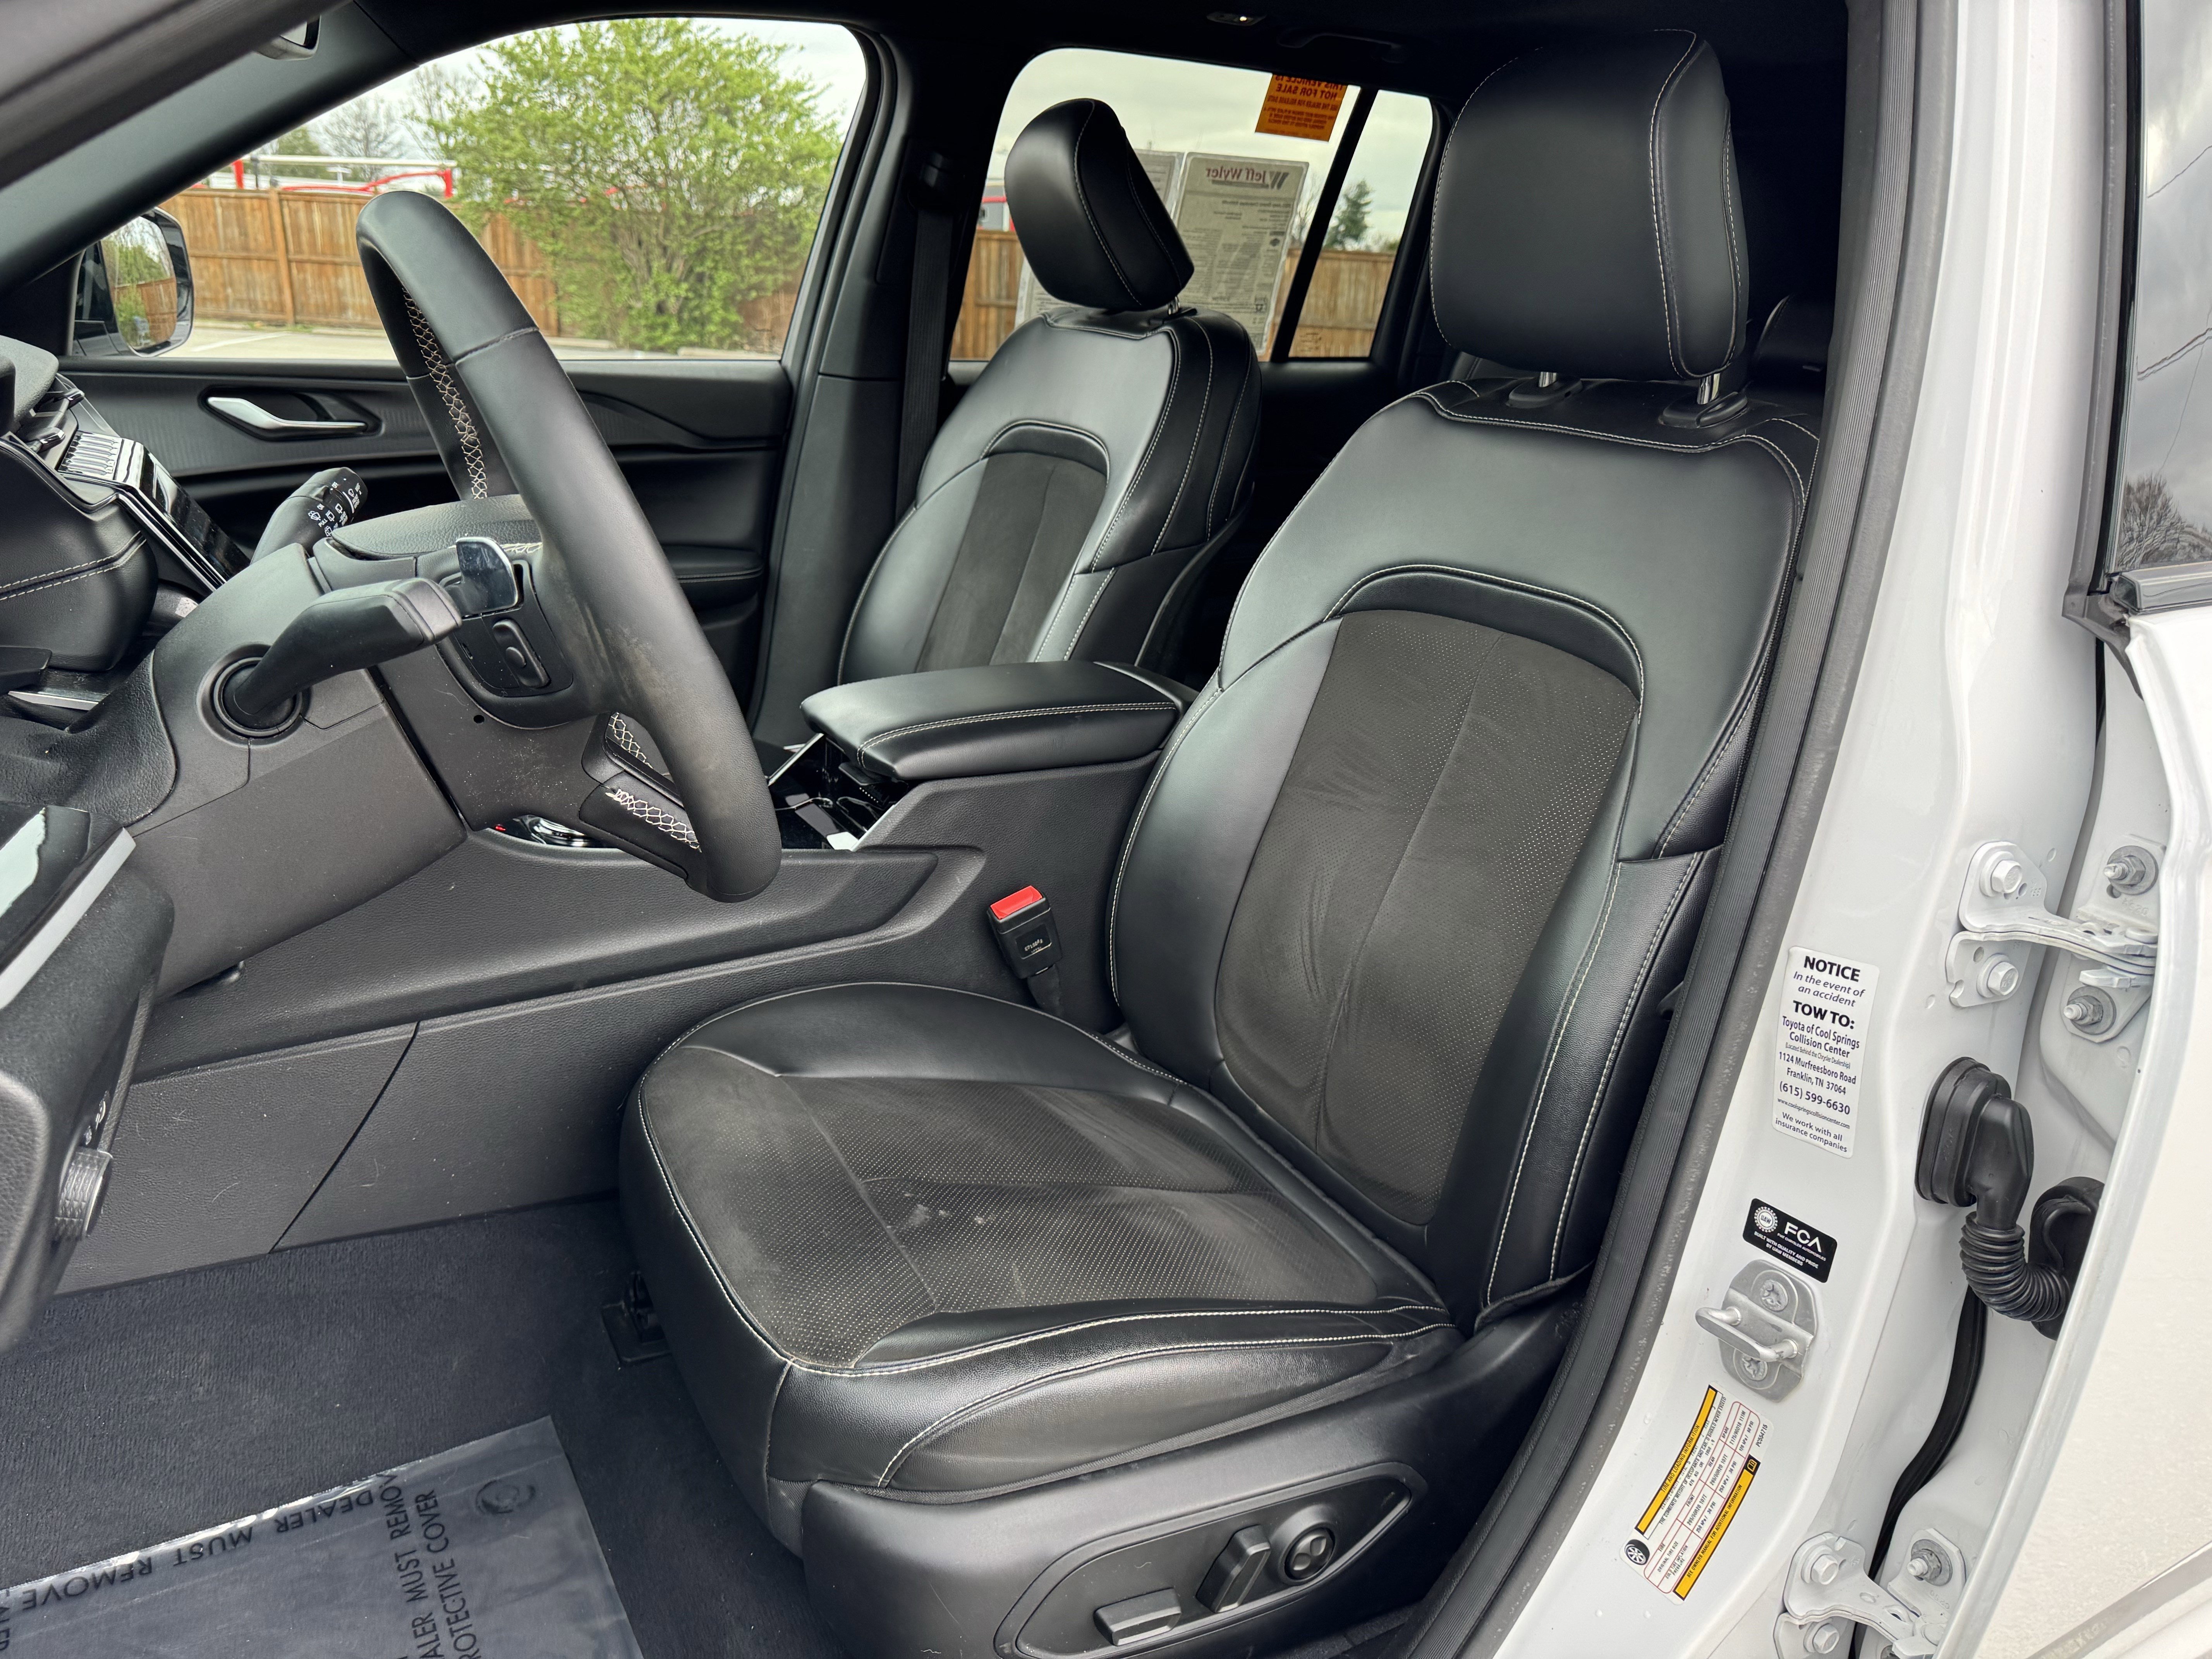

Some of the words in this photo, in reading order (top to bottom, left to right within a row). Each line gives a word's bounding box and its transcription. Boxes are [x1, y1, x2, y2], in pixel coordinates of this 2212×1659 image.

[318, 518, 328, 527] PULL
[1793, 971, 1803, 981] In
[1805, 975, 1821, 985] the
[1823, 982, 1851, 994] event
[1804, 956, 1860, 982] NOTICE
[1793, 1000, 1827, 1020] TOW
[1830, 1011, 1855, 1029] TO:
[1813, 991, 1856, 1007] accident
[1783, 1016, 1805, 1031] Toyota
[1807, 1024, 1815, 1034] of
[1815, 1026, 1831, 1039] Cool
[1832, 1031, 1860, 1050] Springs
[1790, 1032, 1822, 1049] Collision
[1824, 1042, 1850, 1058] Center
[1779, 1051, 1794, 1063] 1124
[1795, 1056, 1838, 1078] Murfreesboro
[1839, 1072, 1856, 1084] Road
[1787, 1067, 1814, 1085] Franklin,
[1815, 1077, 1824, 1087] TN
[1826, 1081, 1846, 1095] 37064
[1780, 1081, 1802, 1099] (615)
[1805, 1091, 1850, 1115] 599-6630
[1776, 1118, 1808, 1137] insurance
[1809, 1133, 1847, 1152] companies
[1783, 1112, 1793, 1121] We
[1795, 1118, 1813, 1130] work
[1815, 1127, 1831, 1137] with
[1766, 1238, 1778, 1246] WITH
[1778, 1244, 1796, 1255] QUALITY
[1784, 1222, 1822, 1252] FCA
[1782, 1252, 1803, 1266] MEMBERS
[1675, 1453, 1686, 1473] LOADING
[1685, 1425, 1700, 1454] INFORMTION
[1676, 1484, 1685, 1499] WEIGHT
[1687, 1458, 1700, 1479] OCCUPANTS
[1701, 1437, 1709, 1450] CARO
[276, 1487, 373, 1534] DEALER
[376, 1473, 411, 1540] REMOV
[1686, 1494, 1695, 1507] FRONT
[415, 1489, 449, 1553] COVER
[1692, 1554, 1703, 1570] OWNERS
[1701, 1540, 1712, 1555] MANUAL
[1715, 1510, 1729, 1531] ADDITIONAL
[1727, 1484, 1742, 1510] INFORMATION
[173, 1527, 253, 1566] MUST
[1677, 1546, 1688, 1562] INFLATION
[395, 1549, 428, 1602] MUST
[1657, 1557, 1669, 1572] ORIGINAL
[1673, 1558, 1685, 1575] PRESSURE
[22, 1556, 153, 1610] REMOVE
[433, 1558, 481, 1659] ROTECTIVE
[412, 1612, 444, 1659] ALER
